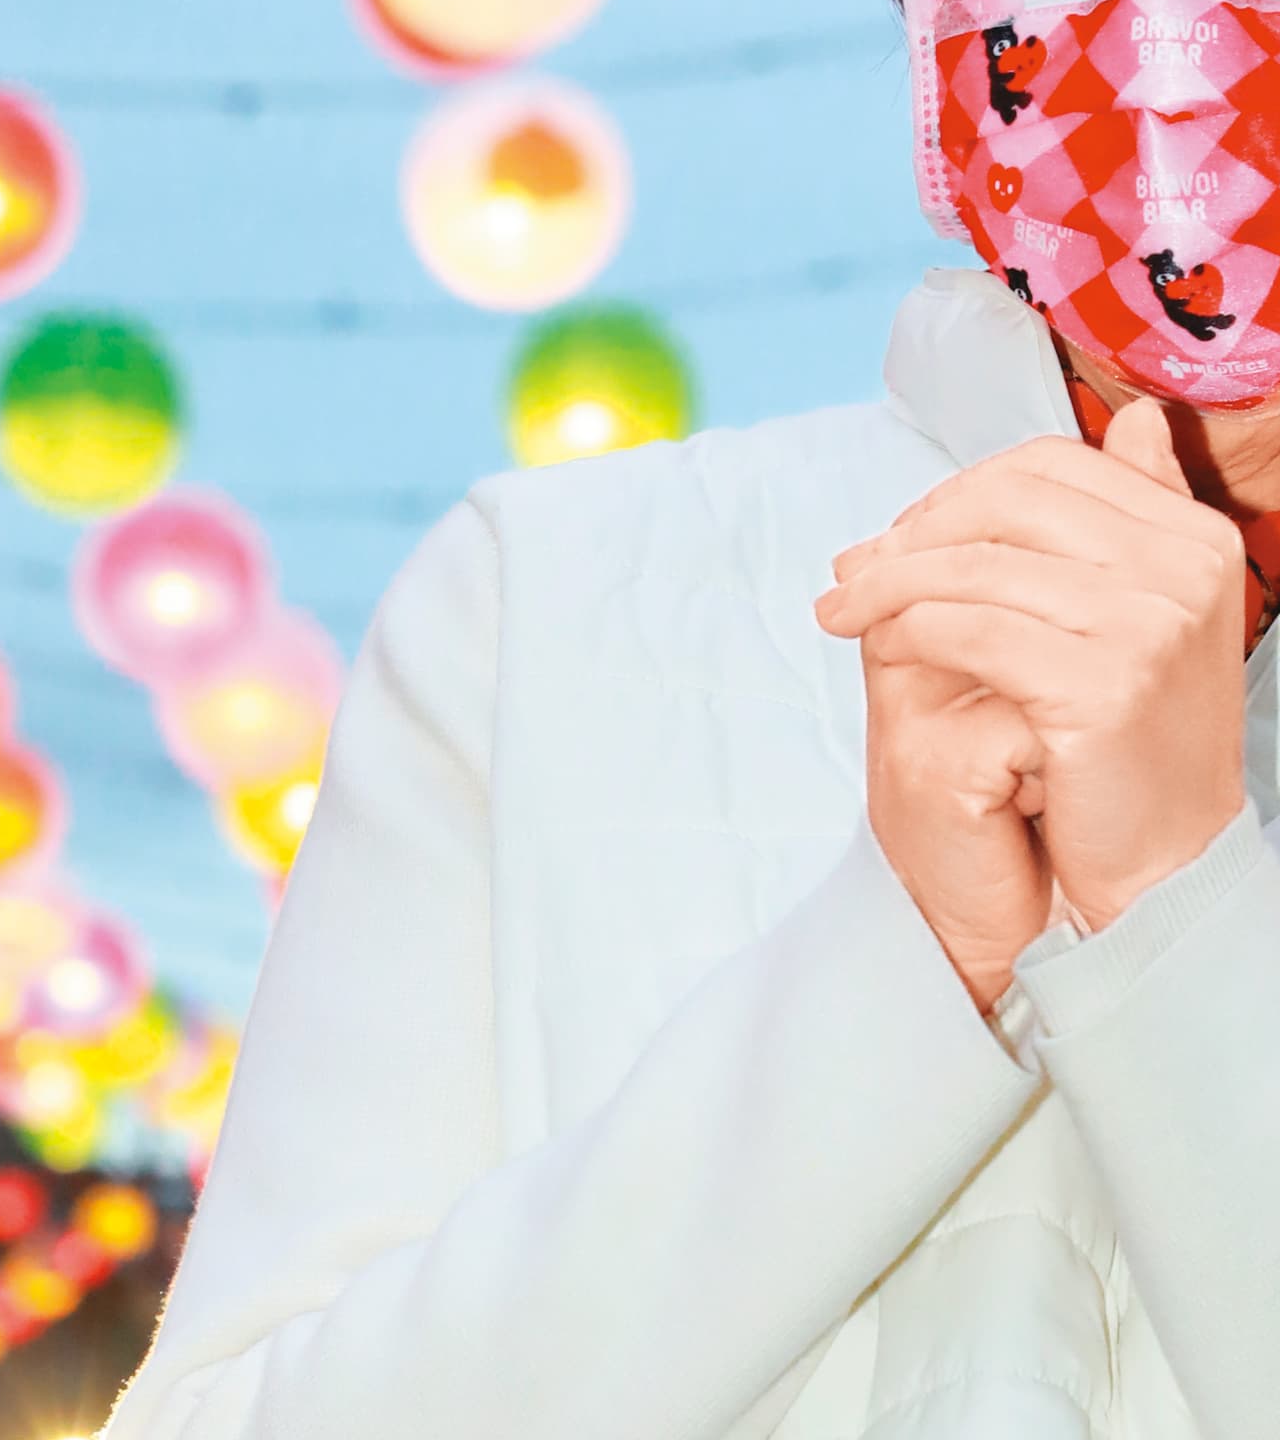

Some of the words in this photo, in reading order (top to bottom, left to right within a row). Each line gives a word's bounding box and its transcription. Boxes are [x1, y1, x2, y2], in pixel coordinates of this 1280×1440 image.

[1130, 14, 1219, 45] BRAVO!
[1138, 40, 1203, 67] BEAR
[1135, 171, 1219, 200] BRAVO!
[1142, 198, 1208, 225] BEAR
[1014, 219, 1060, 261] BEAR
